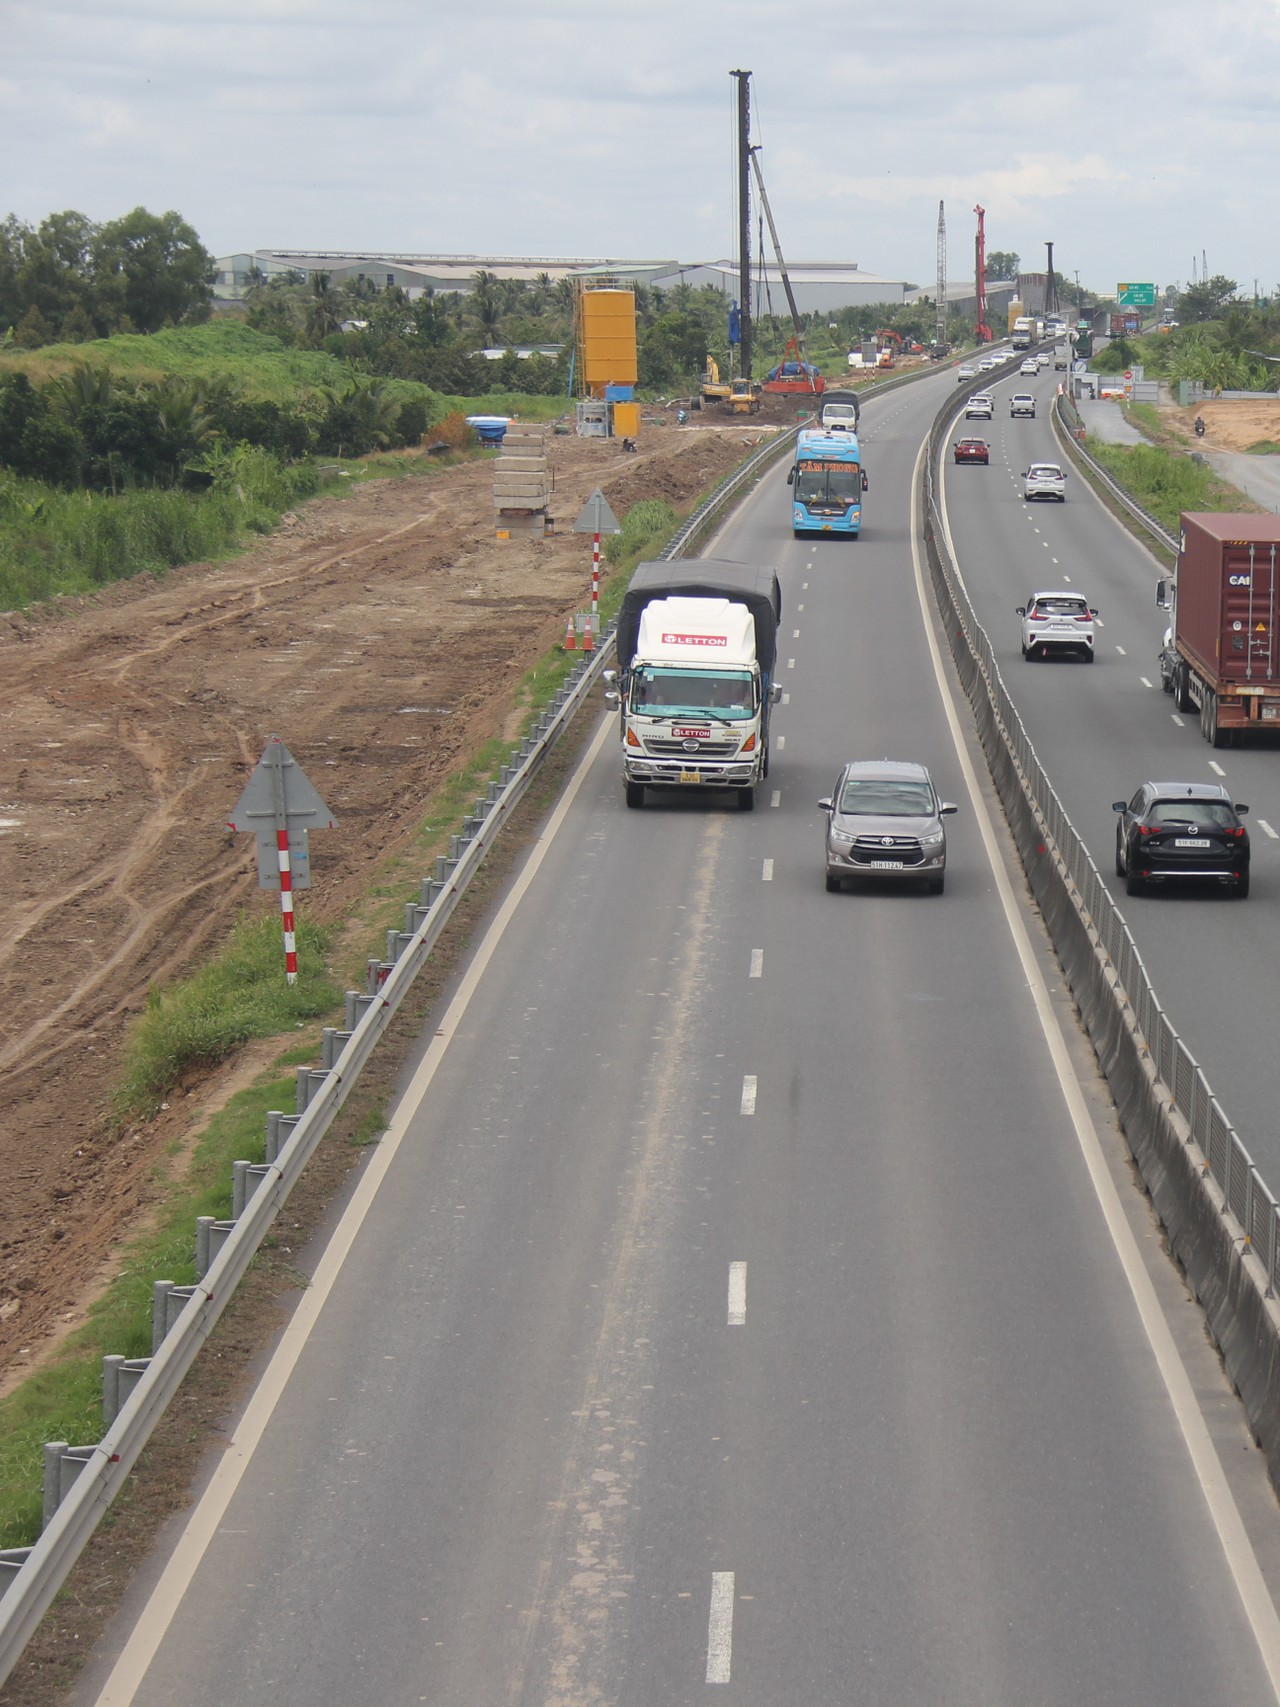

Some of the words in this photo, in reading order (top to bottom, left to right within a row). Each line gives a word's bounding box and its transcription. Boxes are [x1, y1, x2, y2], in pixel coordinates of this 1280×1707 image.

[800, 461, 822, 472] TÂM
[824, 463, 858, 473] PHONG
[1229, 575, 1250, 586] CAI
[677, 635, 726, 646] LETTON
[680, 729, 710, 737] LETTON
